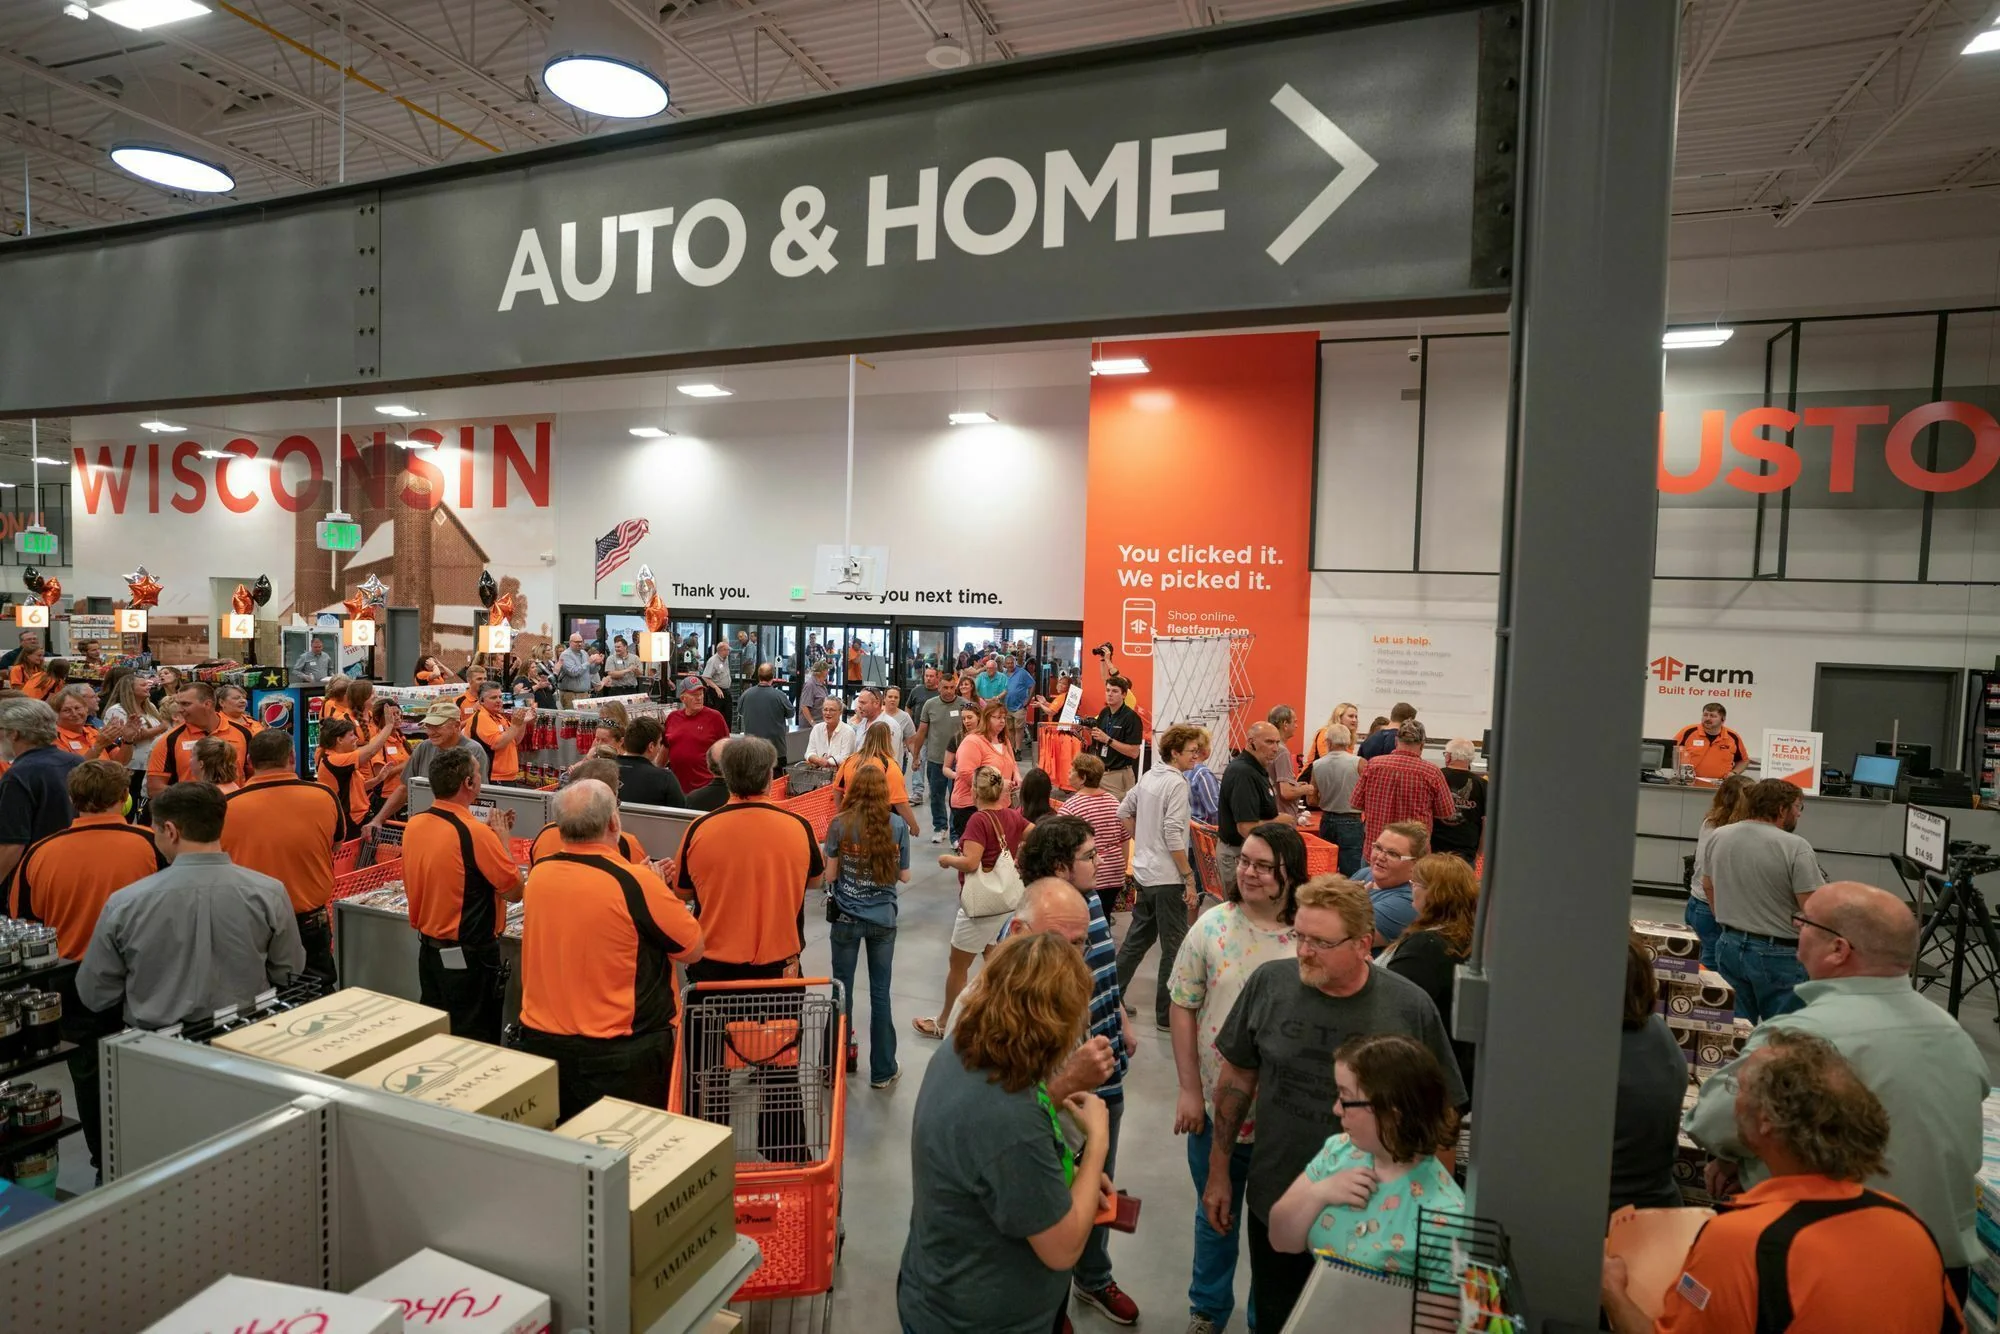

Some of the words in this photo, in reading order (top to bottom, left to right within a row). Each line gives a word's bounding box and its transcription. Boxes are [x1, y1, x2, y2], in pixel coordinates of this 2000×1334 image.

[497, 198, 747, 312] AUTO
[770, 185, 838, 277] &
[866, 129, 1227, 267] HOME
[74, 421, 550, 514] WISCONSIN
[1118, 544, 1160, 563] You
[1167, 544, 1252, 564] clicked
[1260, 545, 1283, 565] it.
[1117, 569, 1153, 587] We
[1160, 569, 1240, 591] picked
[1248, 571, 1271, 590] it.
[672, 583, 715, 598] Thank
[719, 586, 750, 600] you.
[879, 589, 909, 604] you
[915, 589, 952, 603] next
[958, 588, 1003, 605] time.
[28, 609, 42, 624] 6
[128, 613, 140, 629] 5
[1167, 610, 1197, 623] Shop
[1200, 611, 1237, 622] online.
[235, 619, 247, 635] 4
[358, 624, 369, 642] 3
[1167, 624, 1250, 635] fleetfarm.com
[494, 630, 505, 649] 2
[1373, 635, 1389, 644] Let
[1392, 637, 1404, 645] us
[1406, 635, 1432, 647] help.
[1684, 664, 1754, 684] Farm
[1658, 685, 1685, 695] Built
[1688, 687, 1704, 696] for
[1708, 688, 1730, 697] real
[1733, 689, 1752, 698] life
[1772, 743, 1811, 755] TEAM
[1772, 753, 1810, 761] MEMBERS
[309, 1014, 405, 1054] TAMARACK
[654, 1165, 719, 1228] TAMARACK
[653, 1222, 719, 1290] TAMARACK
